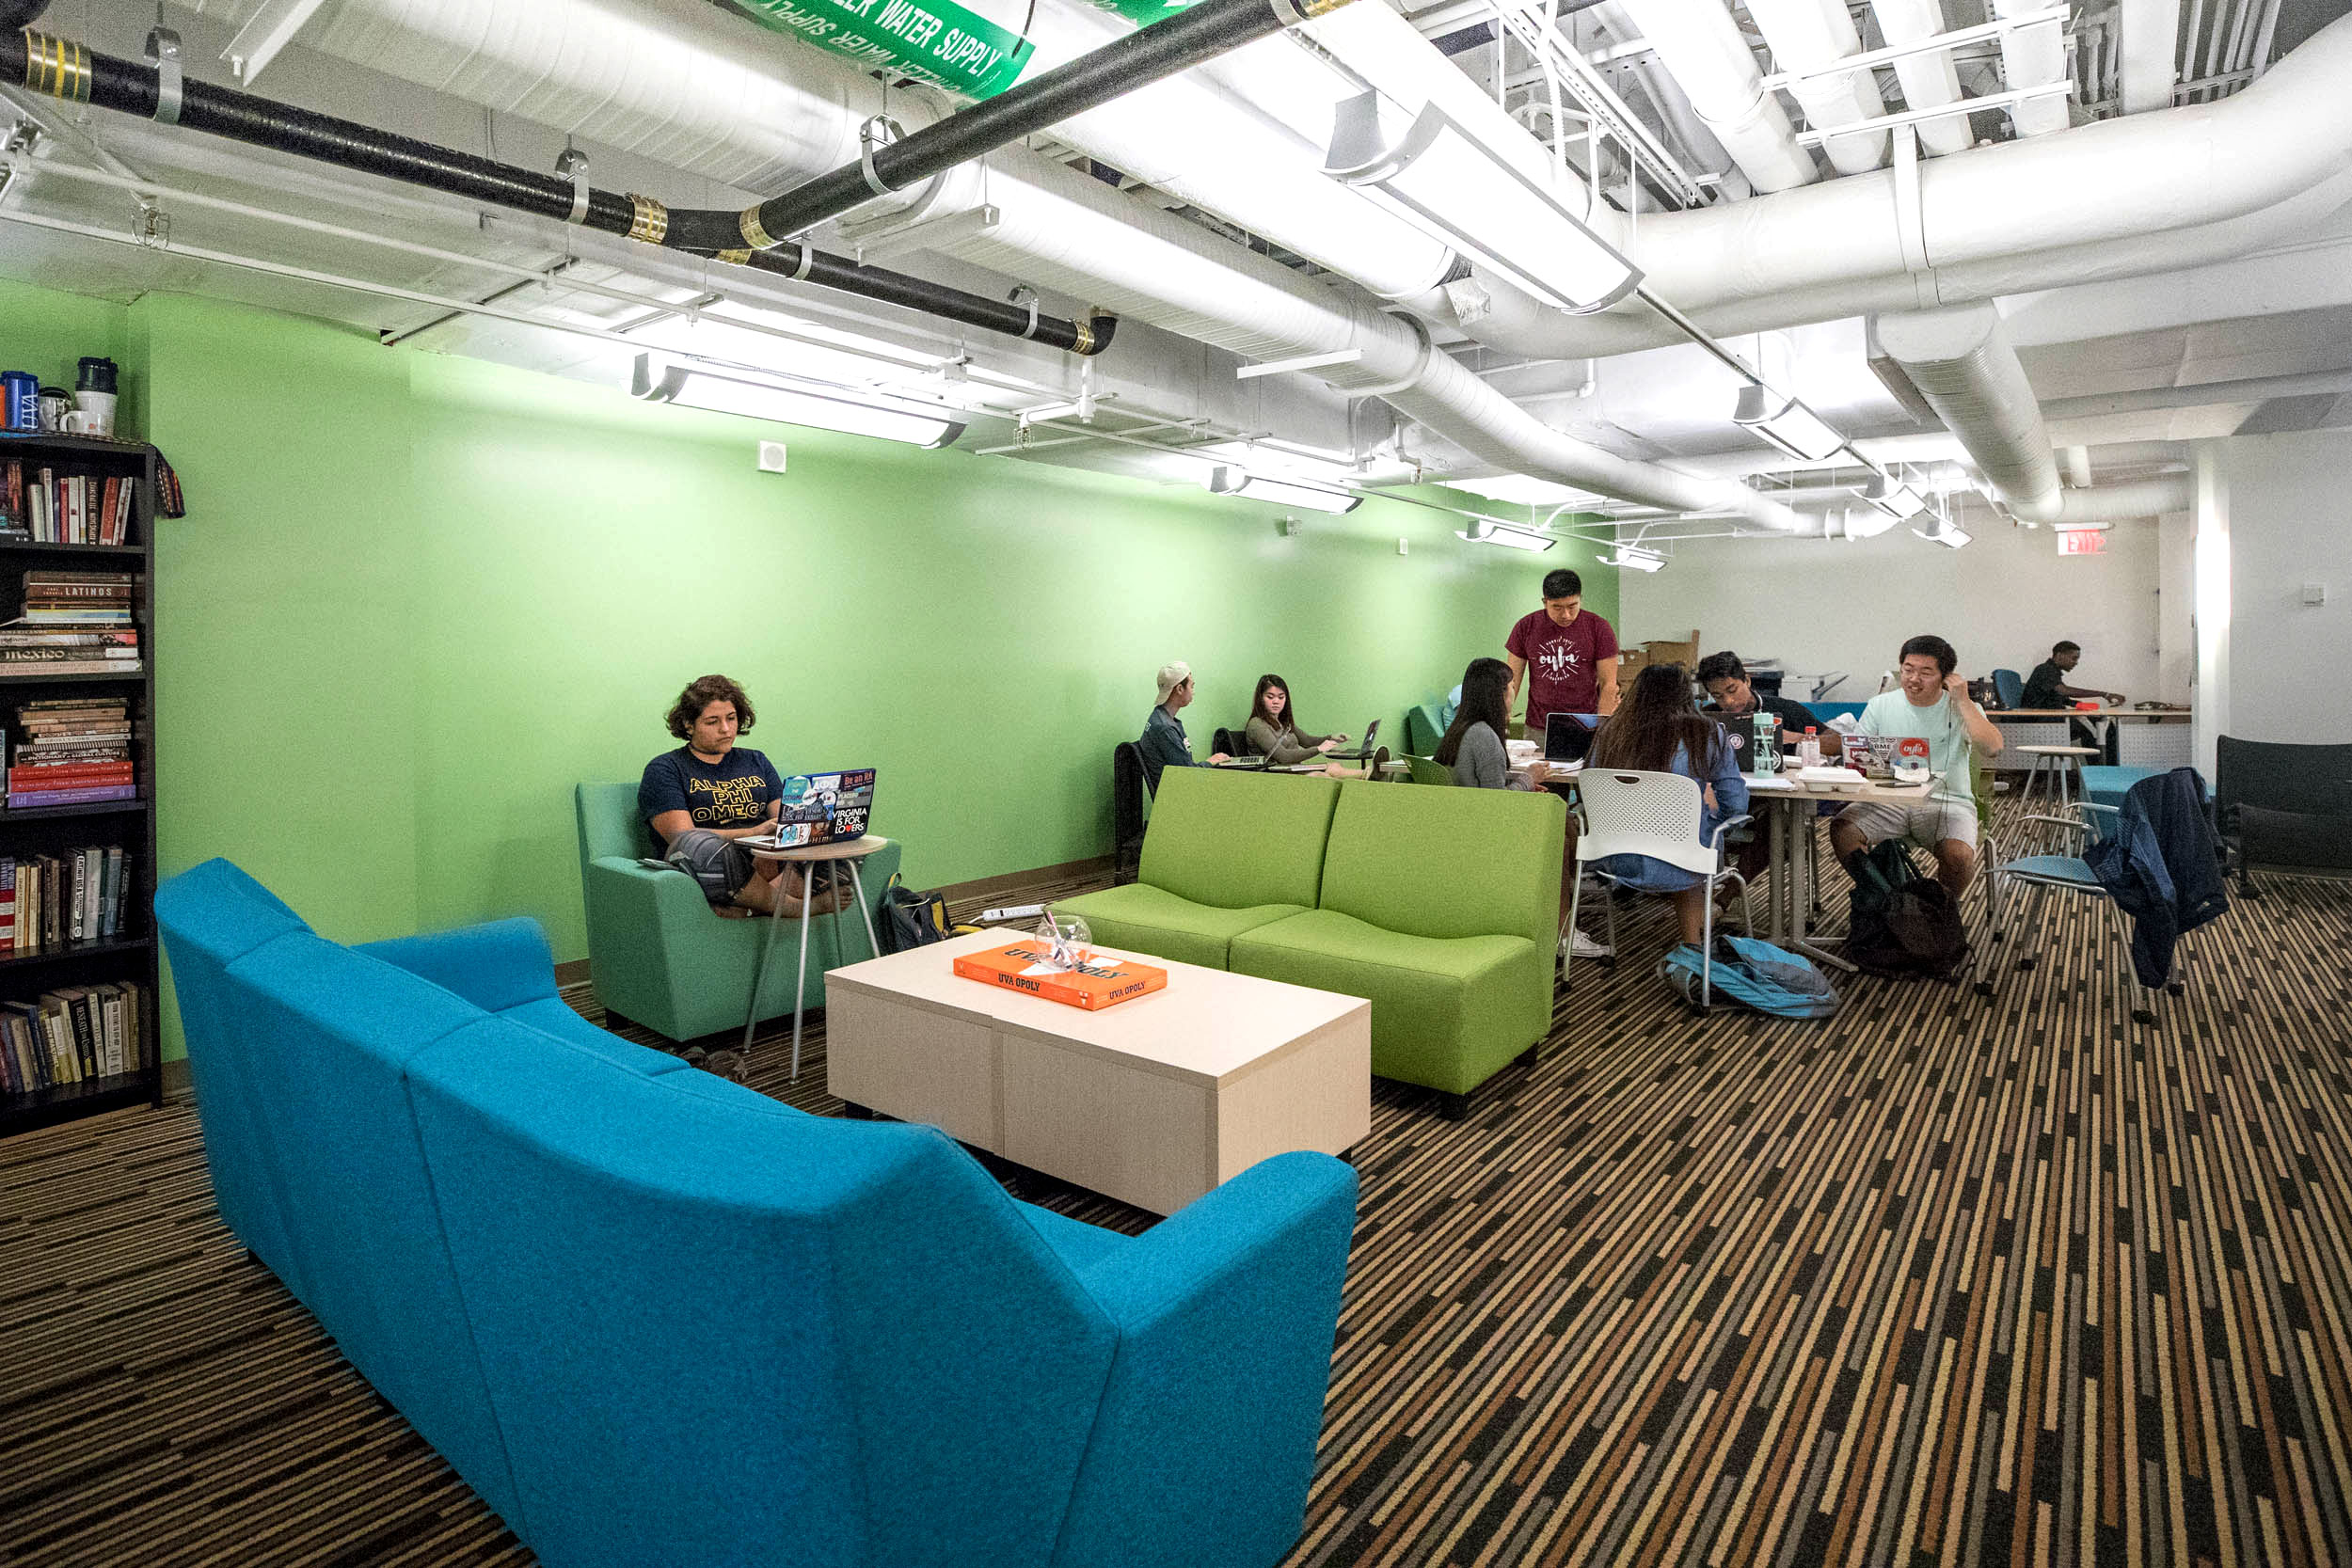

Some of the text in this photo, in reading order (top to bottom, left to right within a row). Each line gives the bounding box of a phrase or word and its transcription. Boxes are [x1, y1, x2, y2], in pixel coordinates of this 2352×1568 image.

[759, 0, 837, 36] SUPPLY
[828, 31, 898, 64] WATER
[874, 0, 943, 49] WATER
[933, 28, 1003, 77] SUPPLY
[22, 393, 39, 429] UVA
[2067, 530, 2101, 553] EXIT
[65, 587, 112, 595] LATINOS
[5, 648, 65, 659] mexico
[690, 775, 767, 793] ALPHA
[844, 776, 853, 785] Be
[854, 774, 863, 784] an
[712, 788, 753, 805] PHI
[833, 808, 867, 818] VIRGINIA
[845, 816, 861, 826] FOR
[998, 973, 1041, 992] UVA OPOLY
[1109, 981, 1145, 999] UVA OPOLY
[76, 1006, 89, 1033] BENEATH
